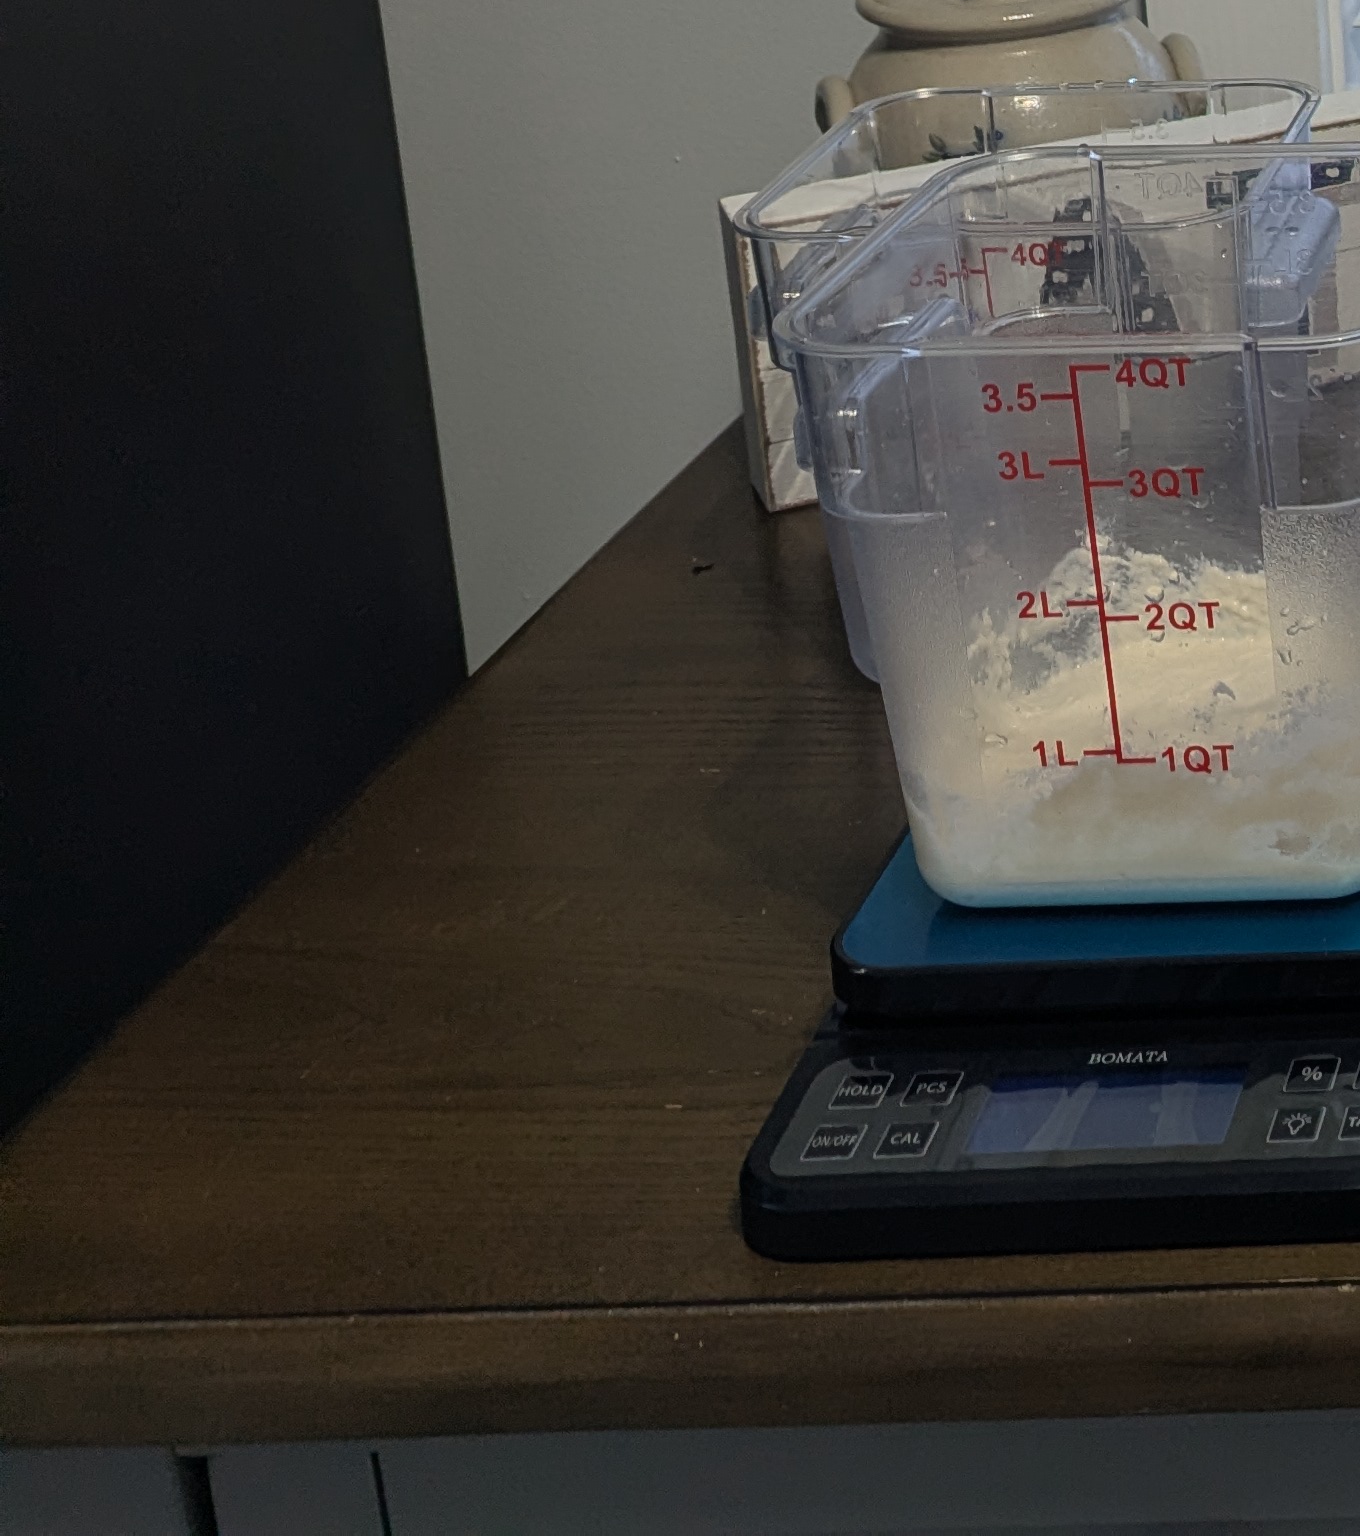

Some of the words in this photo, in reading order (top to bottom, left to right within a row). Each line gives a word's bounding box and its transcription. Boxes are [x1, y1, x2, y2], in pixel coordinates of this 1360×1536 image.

[1115, 357, 1192, 389] 4QT
[981, 382, 1038, 413] 3.5
[997, 450, 1045, 481] 3L
[1128, 467, 1205, 498] 3QT
[1016, 590, 1064, 619] 2L
[1144, 601, 1220, 631] 2QT
[1032, 740, 1079, 767] 1L
[1161, 744, 1235, 774] 1QT
[1088, 1050, 1169, 1065] BOMATA
[916, 1081, 948, 1094] PCS
[1301, 1065, 1323, 1082] %
[838, 1085, 884, 1097] HOLD
[812, 1134, 858, 1148] ON/OFF
[890, 1131, 921, 1145] CAL
